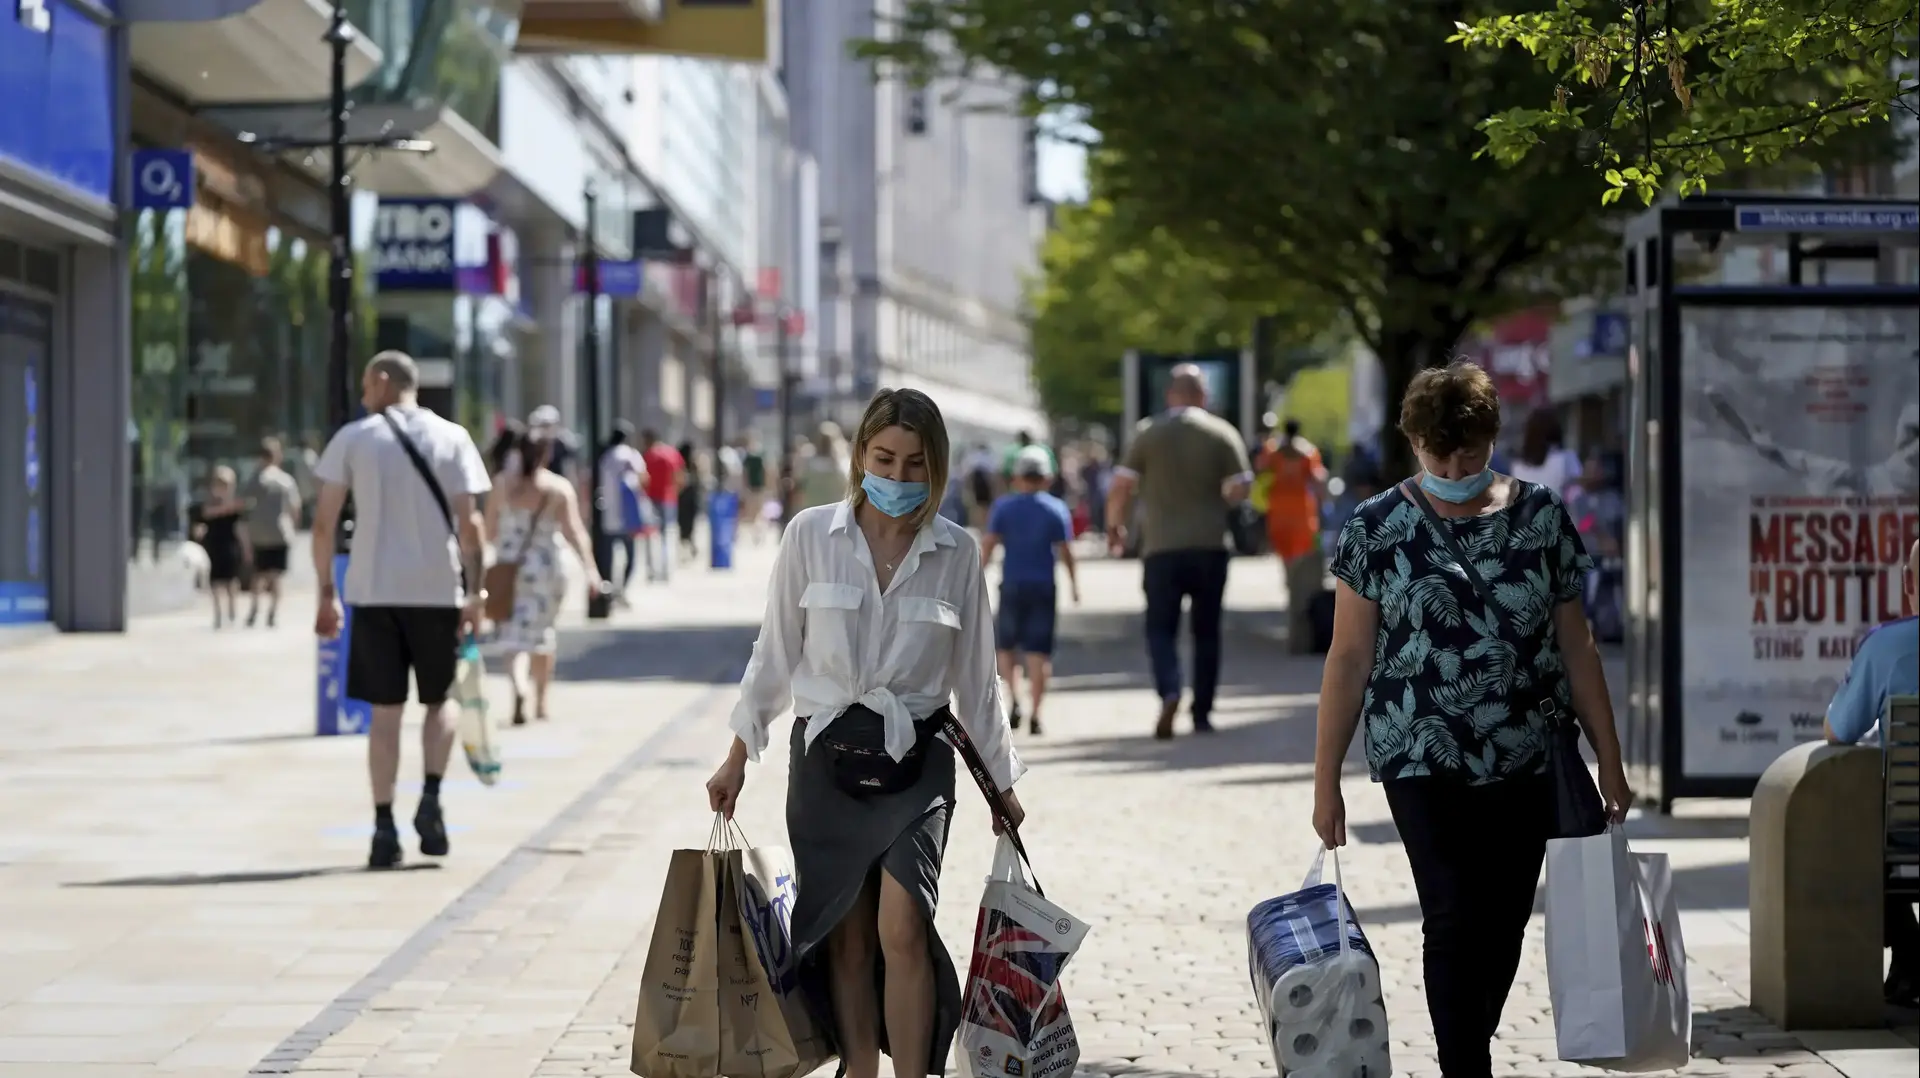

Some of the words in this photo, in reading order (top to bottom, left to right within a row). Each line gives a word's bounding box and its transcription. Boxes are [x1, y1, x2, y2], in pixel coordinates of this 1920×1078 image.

[1775, 568, 1910, 624] BOTTL
[1753, 635, 1804, 661] STING
[943, 721, 966, 750] ellesse
[973, 766, 993, 799] ellesse
[1029, 1023, 1074, 1052] Champion
